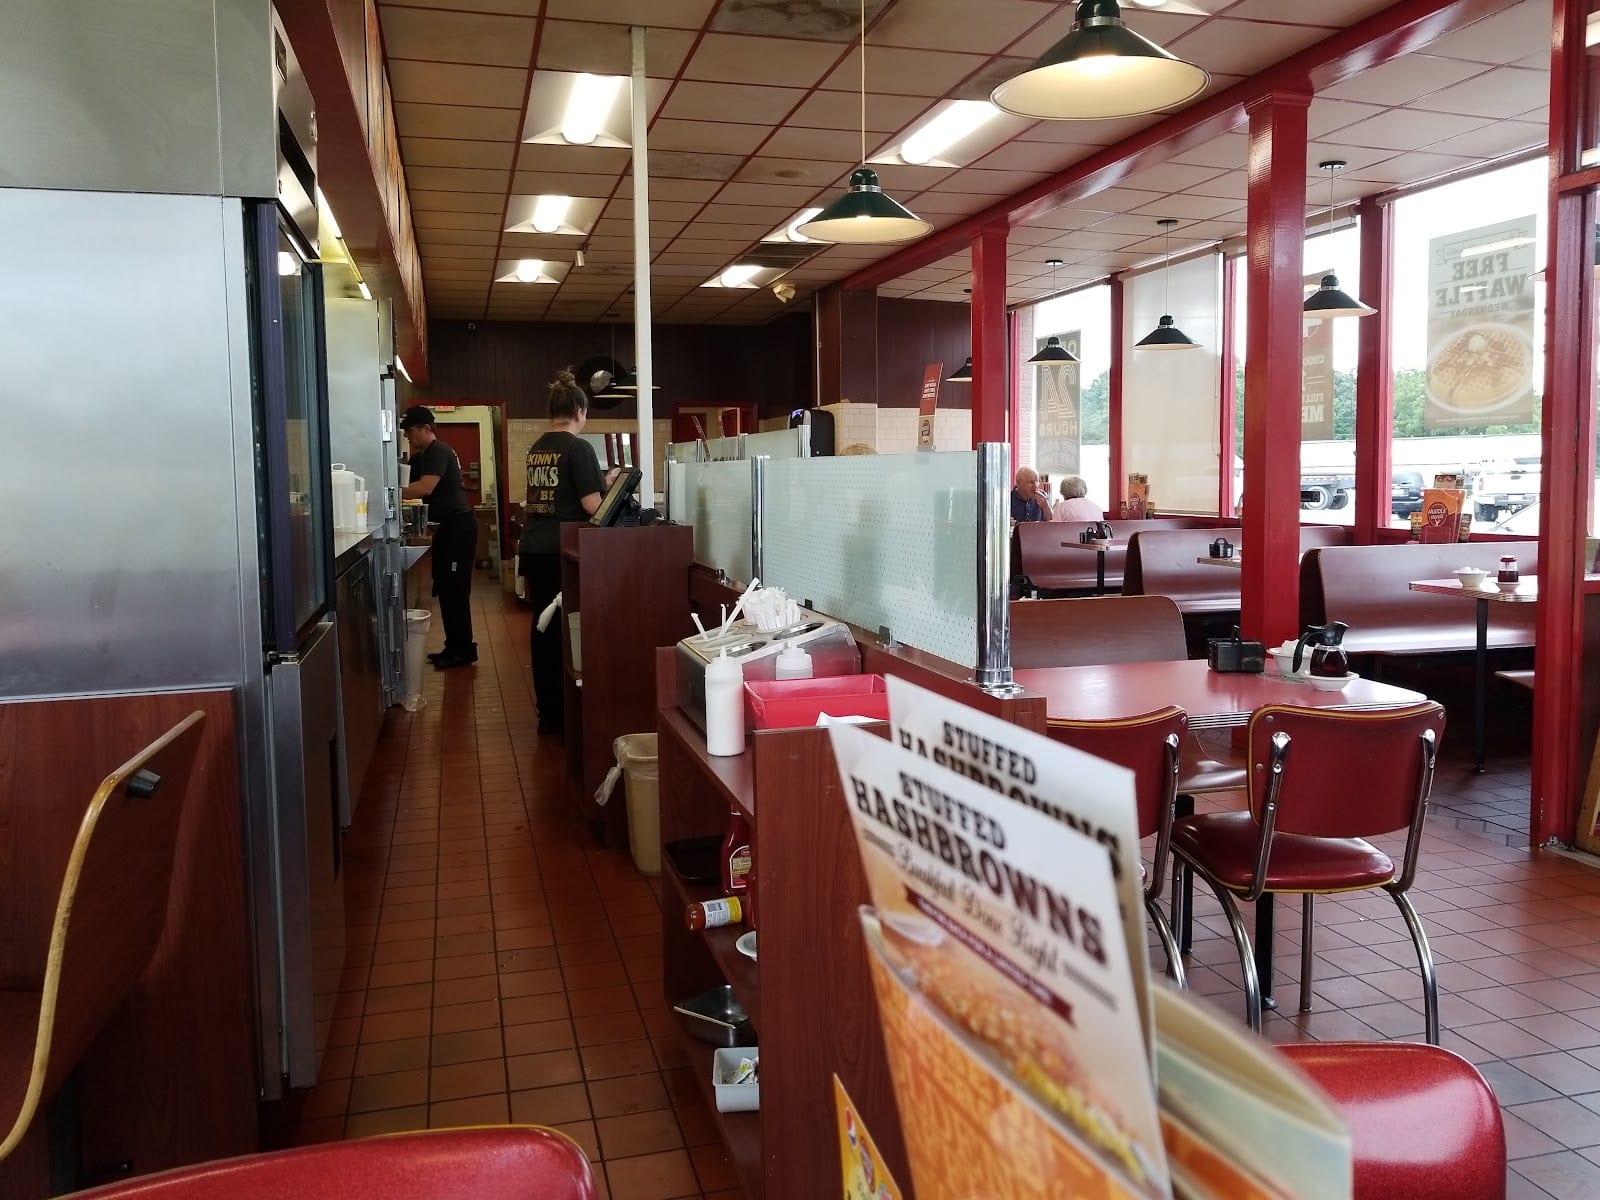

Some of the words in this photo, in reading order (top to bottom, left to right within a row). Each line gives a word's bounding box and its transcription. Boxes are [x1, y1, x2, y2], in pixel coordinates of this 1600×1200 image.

[943, 721, 1037, 786] STUFFED
[898, 771, 1007, 850] STUFFED
[850, 775, 1109, 967] HASHBROWNS
